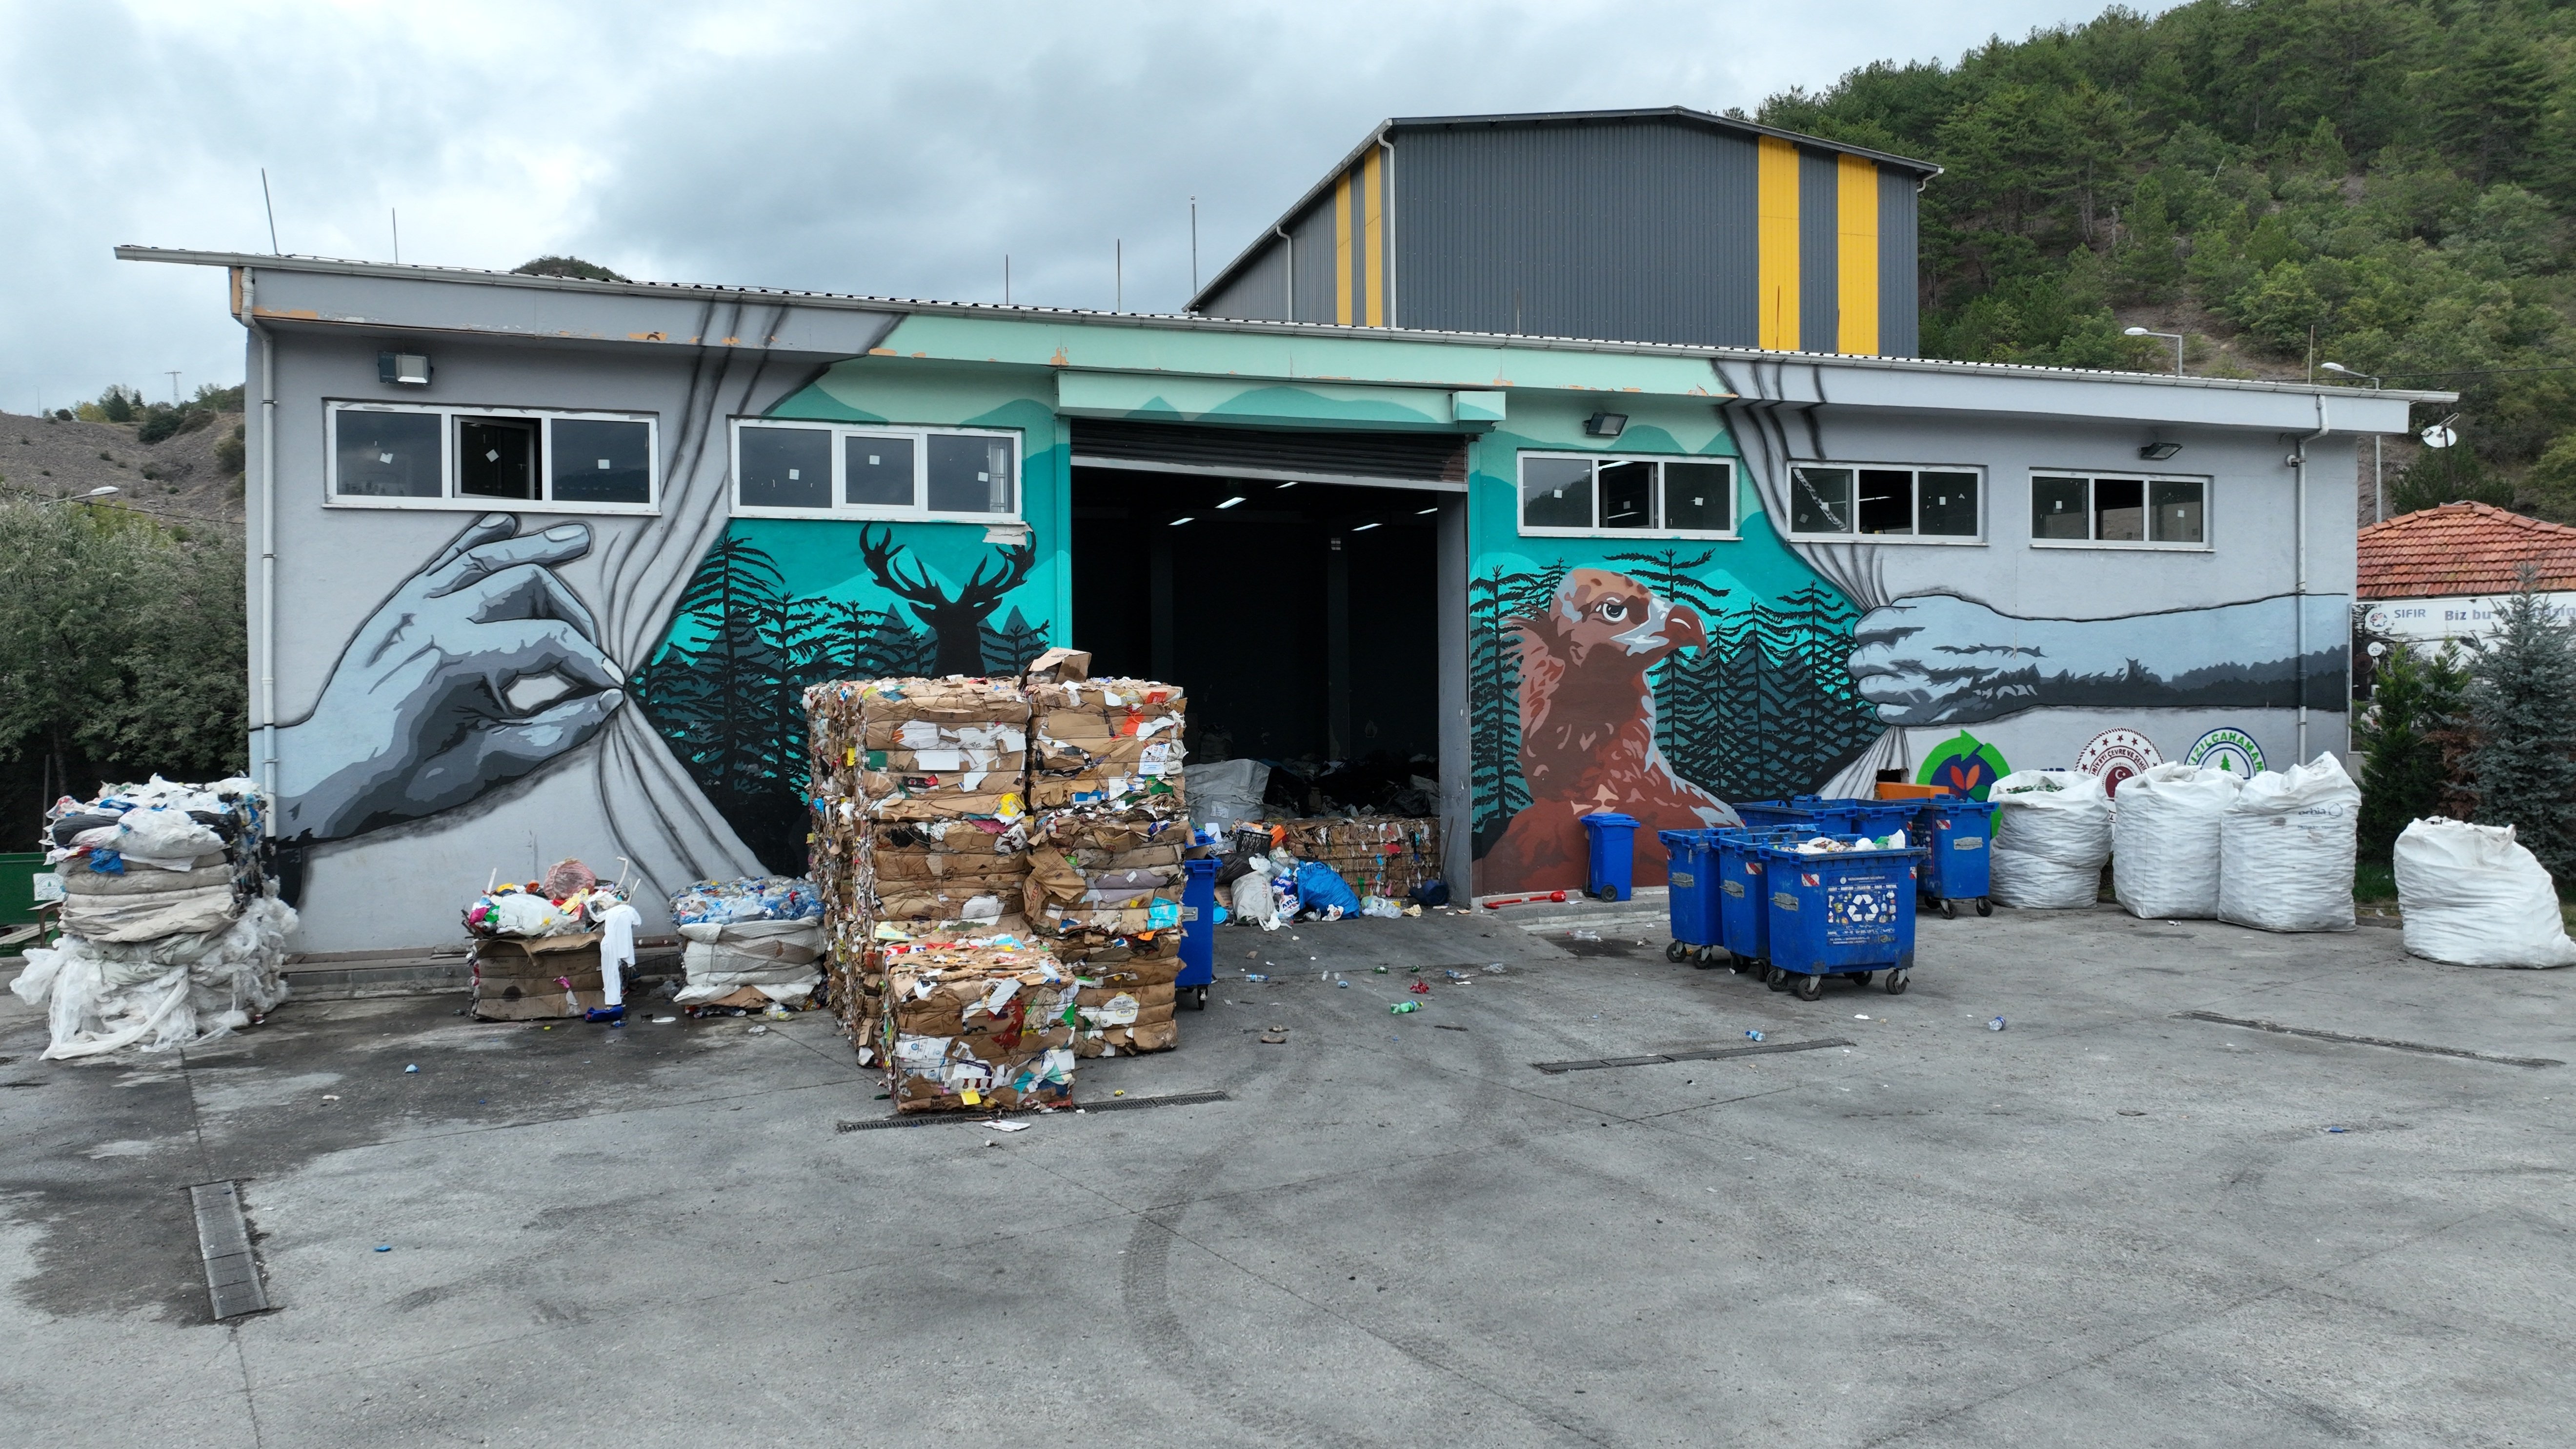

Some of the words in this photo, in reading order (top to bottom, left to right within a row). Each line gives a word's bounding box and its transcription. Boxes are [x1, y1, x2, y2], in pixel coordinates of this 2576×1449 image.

[2394, 609, 2426, 619] SIFIR
[2445, 610, 2466, 621] Biz
[2472, 609, 2491, 620] bu
[2107, 748, 2126, 758] ÇEVRE
[2127, 750, 2134, 758] VE
